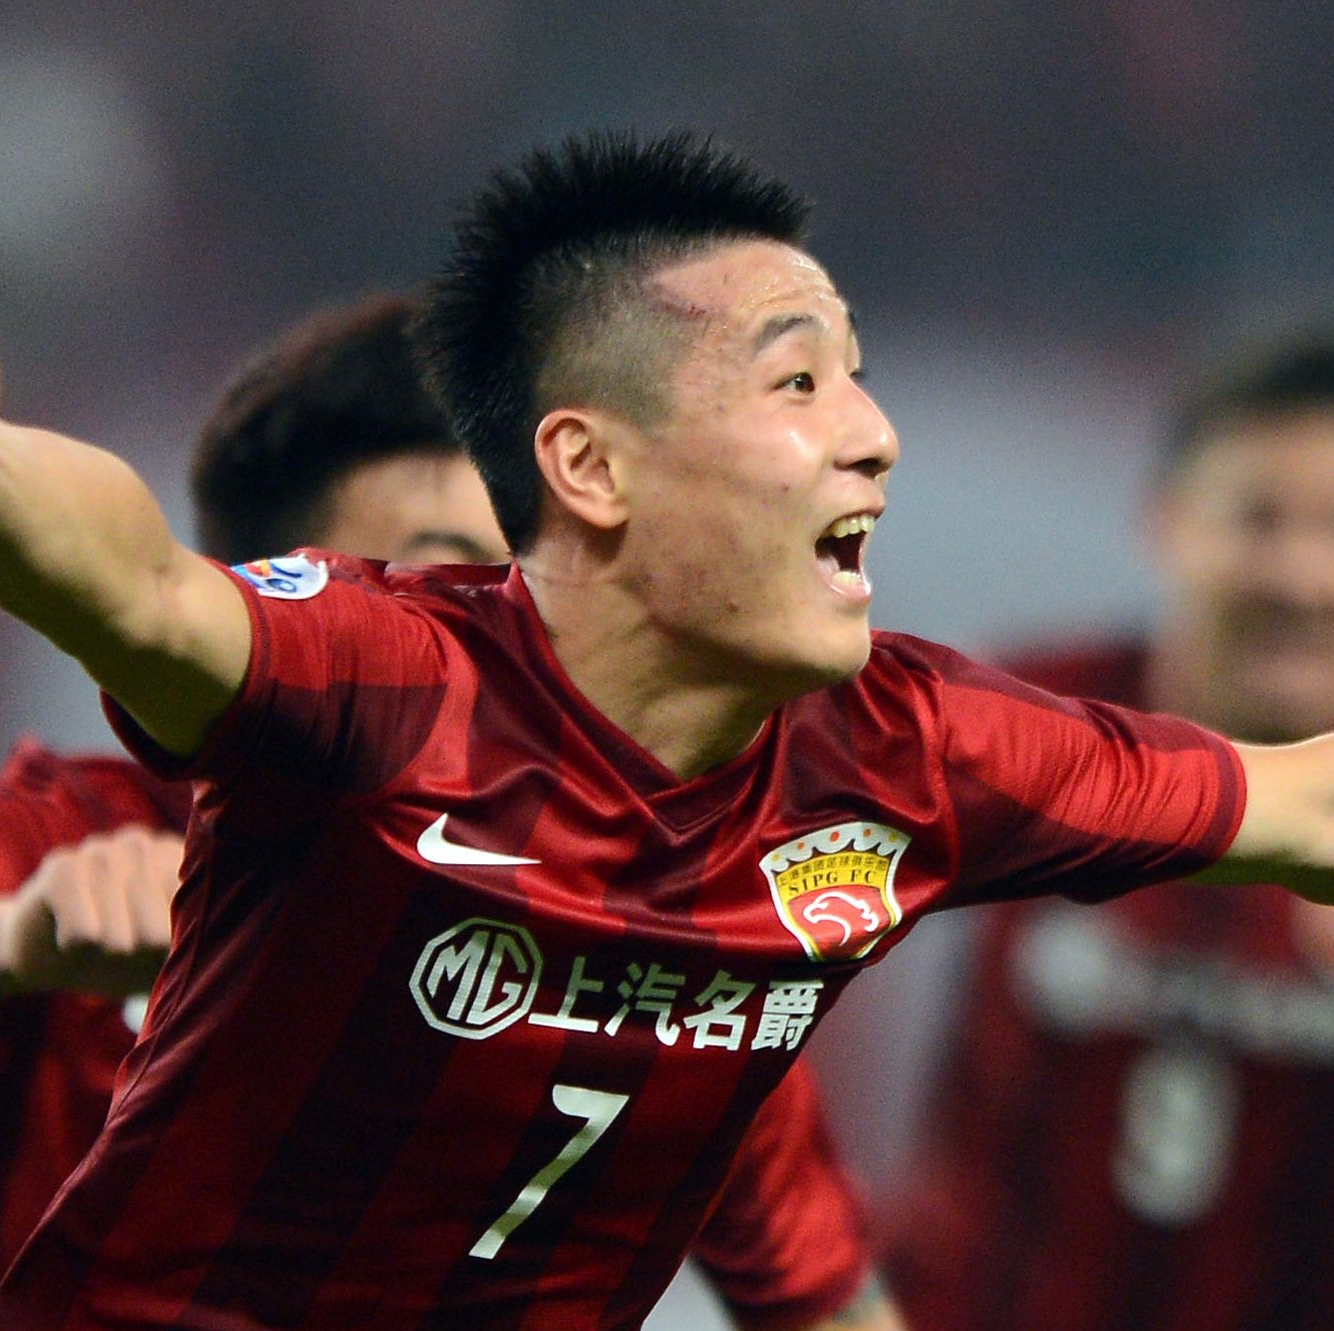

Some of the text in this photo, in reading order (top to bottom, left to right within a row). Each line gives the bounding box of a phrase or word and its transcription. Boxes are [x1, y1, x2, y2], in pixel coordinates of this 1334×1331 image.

[788, 869, 876, 896] SIPG FC
[425, 929, 529, 1027] MG
[528, 956, 825, 1051] 上汽名爵
[468, 1084, 630, 1260] 7
